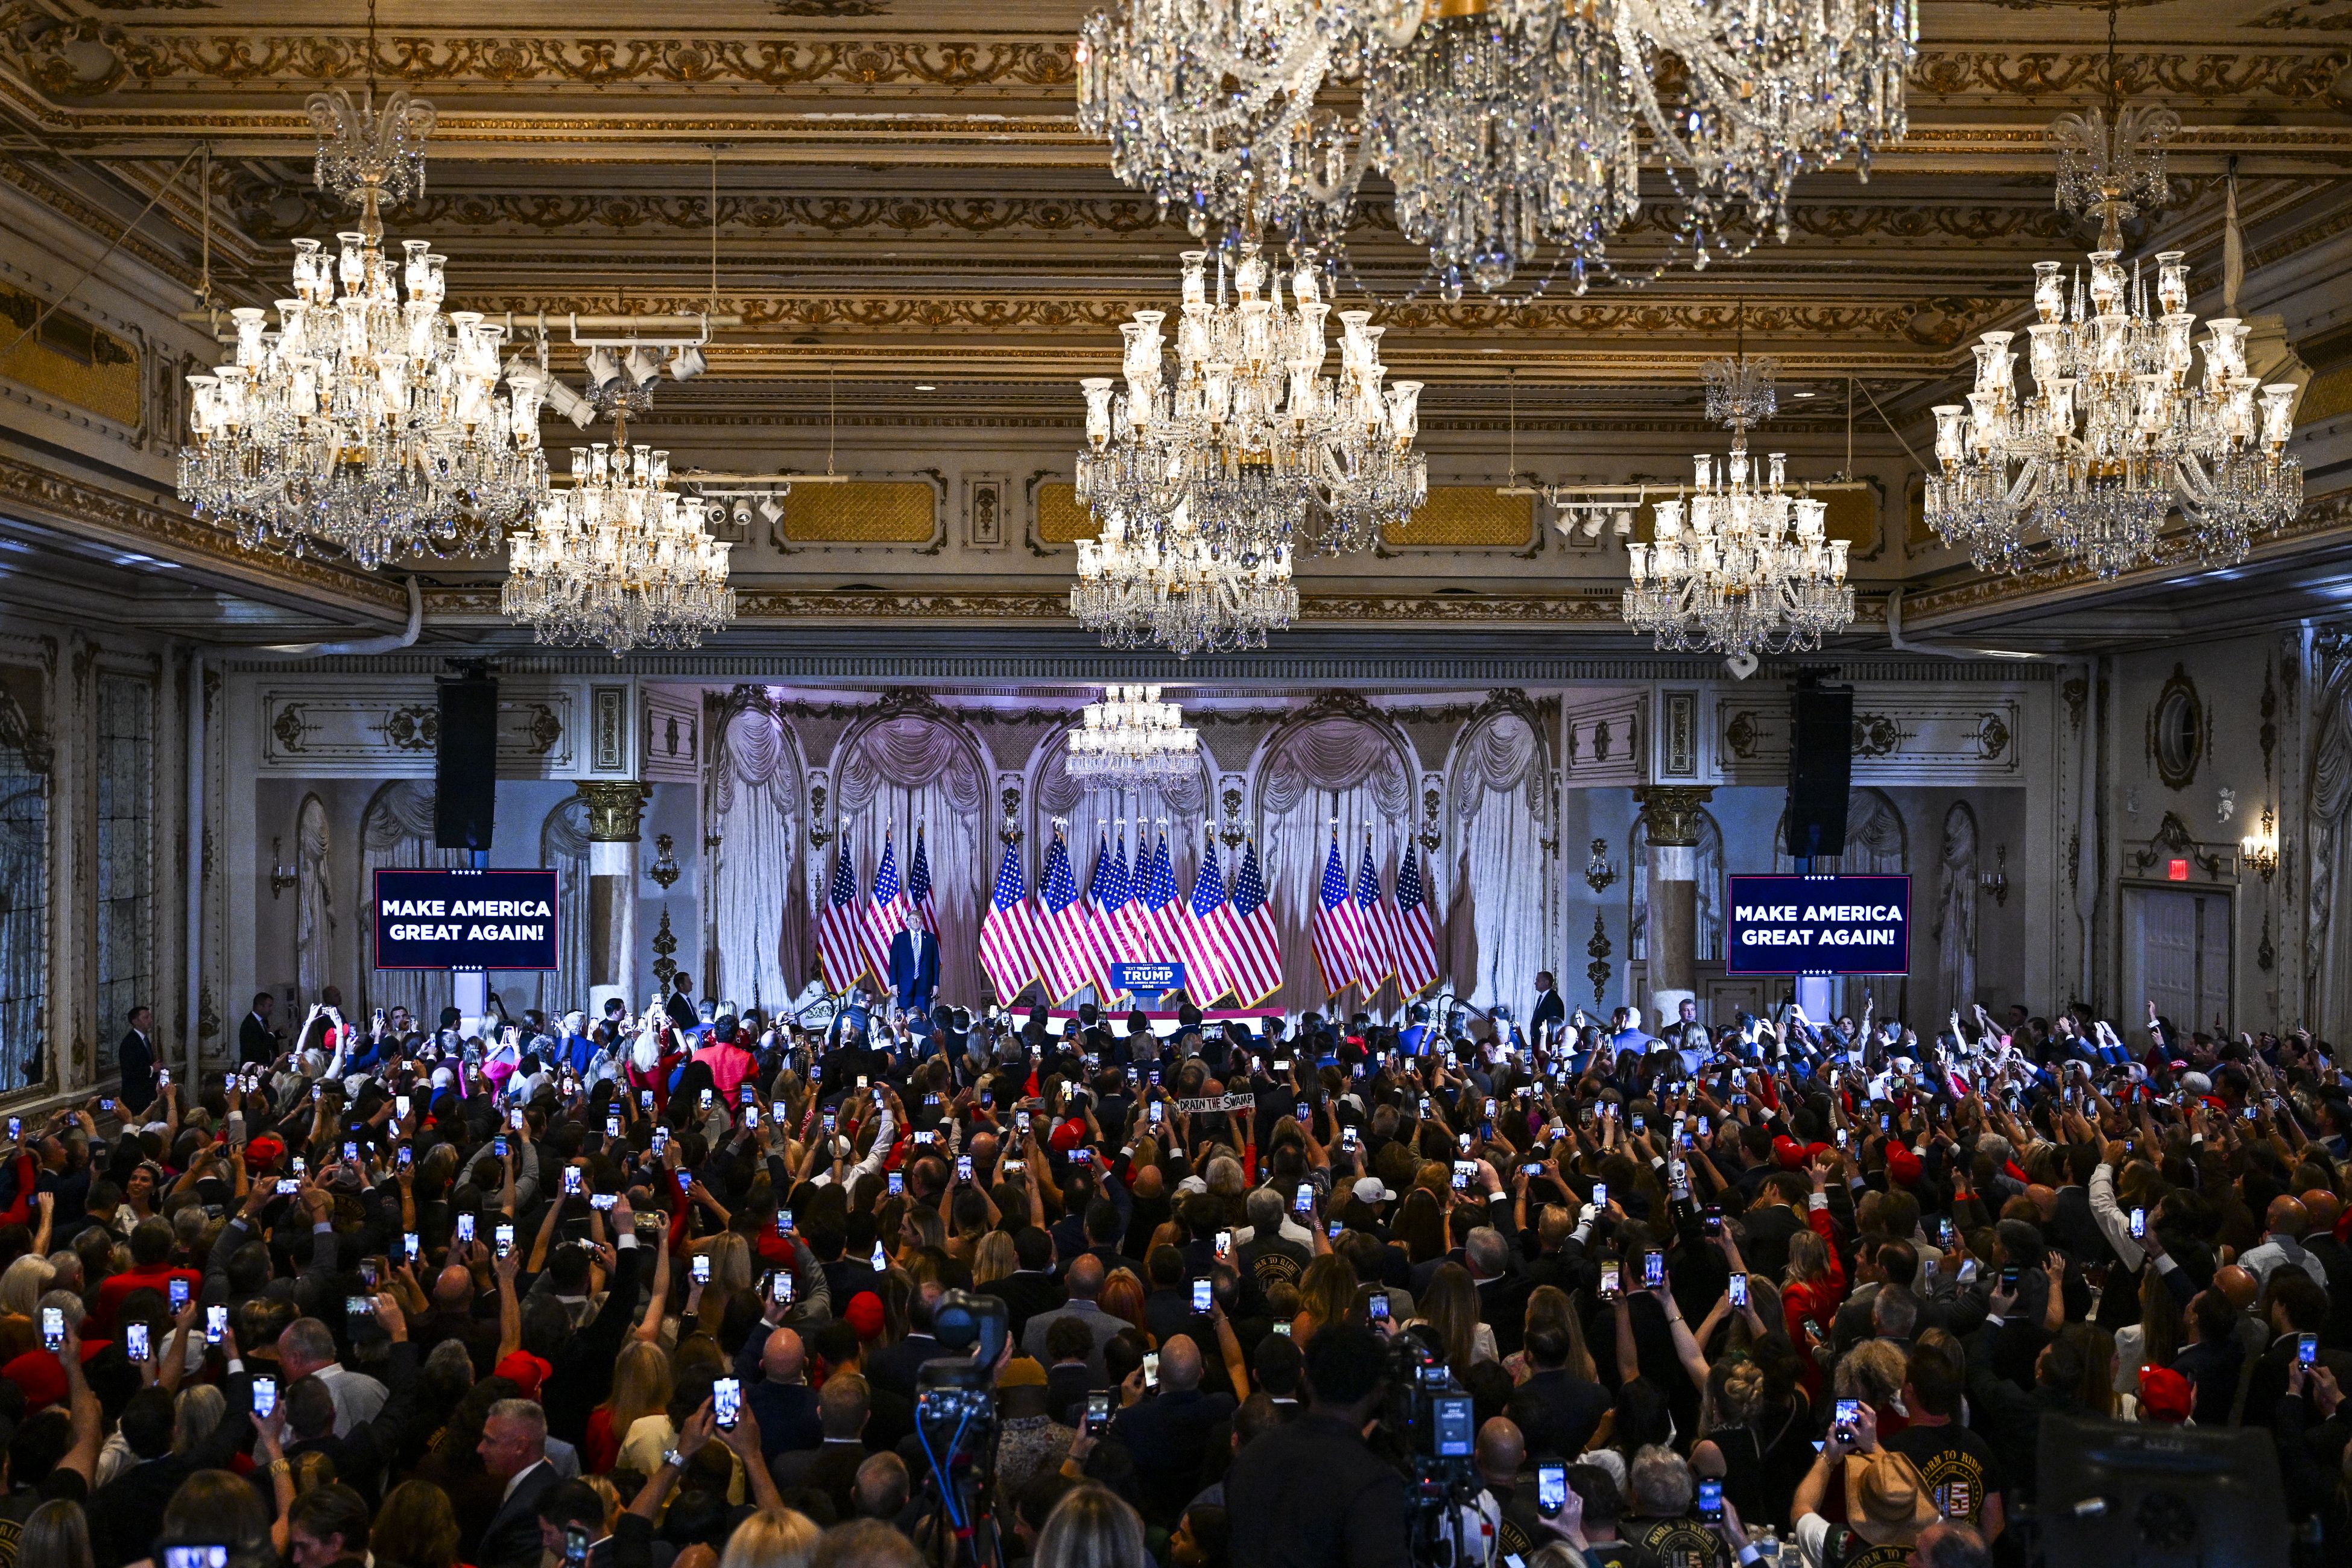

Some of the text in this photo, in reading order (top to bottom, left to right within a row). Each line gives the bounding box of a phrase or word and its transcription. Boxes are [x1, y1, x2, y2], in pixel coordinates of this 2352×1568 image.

[382, 900, 551, 917] MAKE AMERICA
[1736, 905, 1903, 922] MAKE AMERICA
[389, 924, 544, 941] GREAT AGAIN!
[1742, 929, 1895, 945] GREAT AGAIN!
[1122, 971, 1173, 981] TRUMP
[1180, 1095, 1253, 1111] DRAIN THE SWAMP
[1280, 1258, 1297, 1274] RIDE
[1923, 1450, 1983, 1476] ORN TO RIDE
[1501, 1523, 1528, 1552] RIDE
[1649, 1523, 1674, 1545] BORN
[1690, 1523, 1715, 1545] RIDE
[1884, 1549, 1900, 1559] TO
